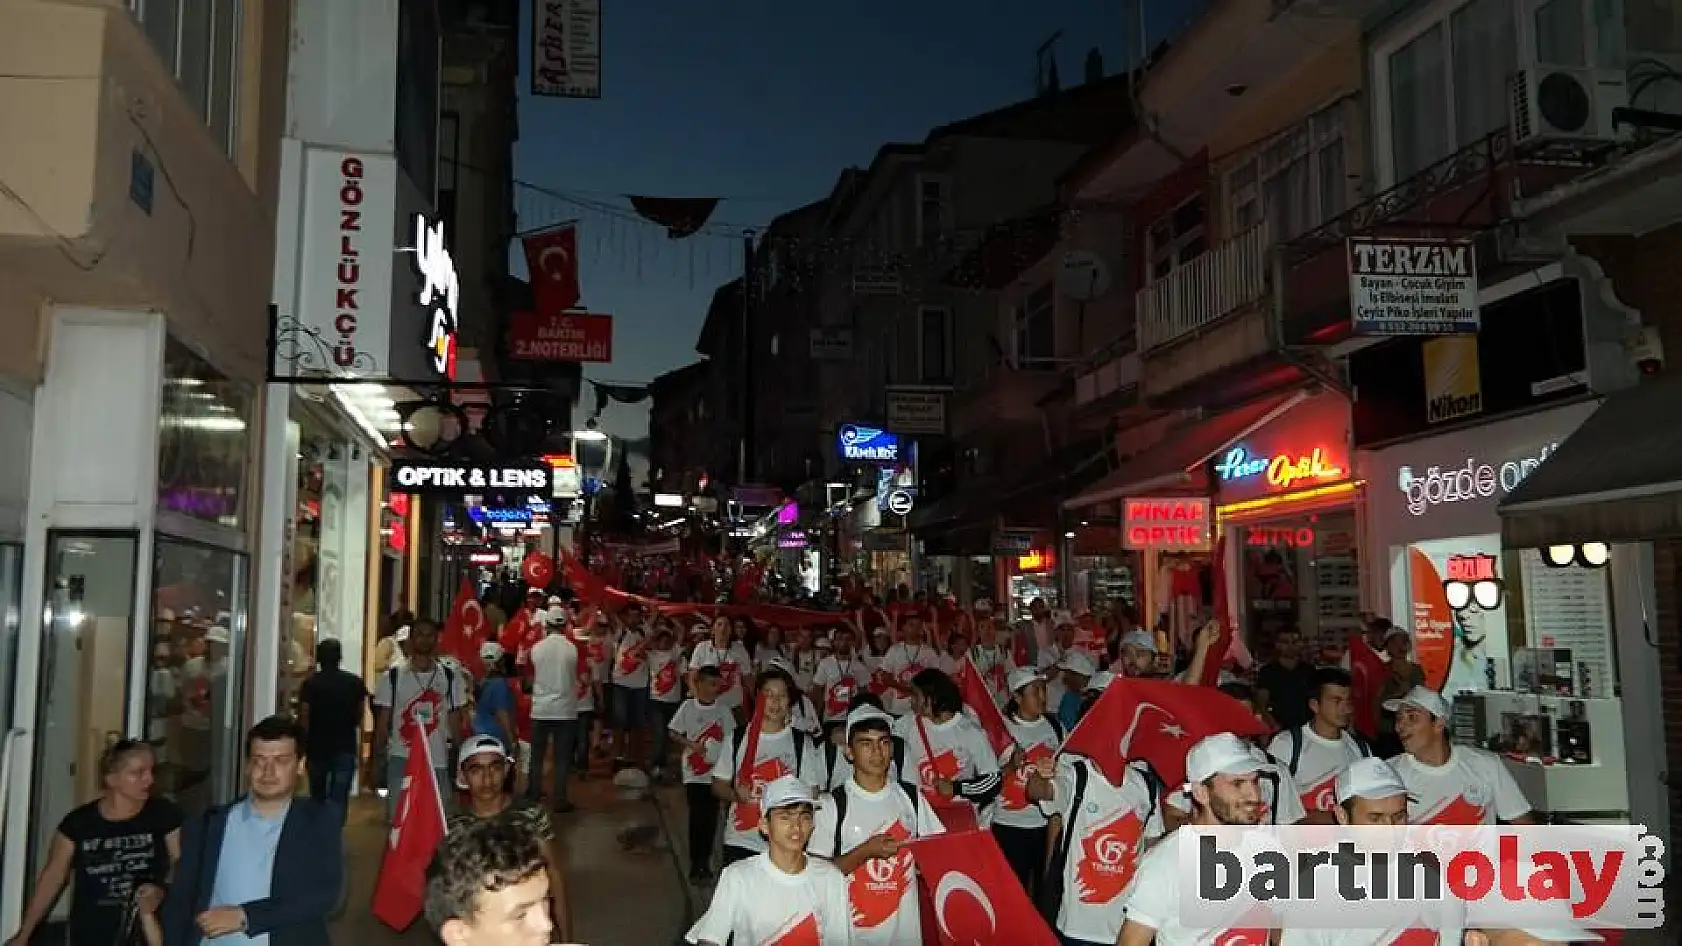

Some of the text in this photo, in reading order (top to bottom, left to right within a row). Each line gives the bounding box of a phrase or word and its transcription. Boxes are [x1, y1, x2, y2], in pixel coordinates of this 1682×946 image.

[333, 157, 363, 367] GÖZLÜKÇÜ
[1360, 277, 1393, 290] Bayan
[1428, 393, 1481, 419] Nikon
[468, 468, 486, 487] &
[489, 468, 548, 488] LENS
[1267, 448, 1341, 487] Optik
[1406, 458, 1497, 516] gözde
[1128, 503, 1205, 521] PINAR
